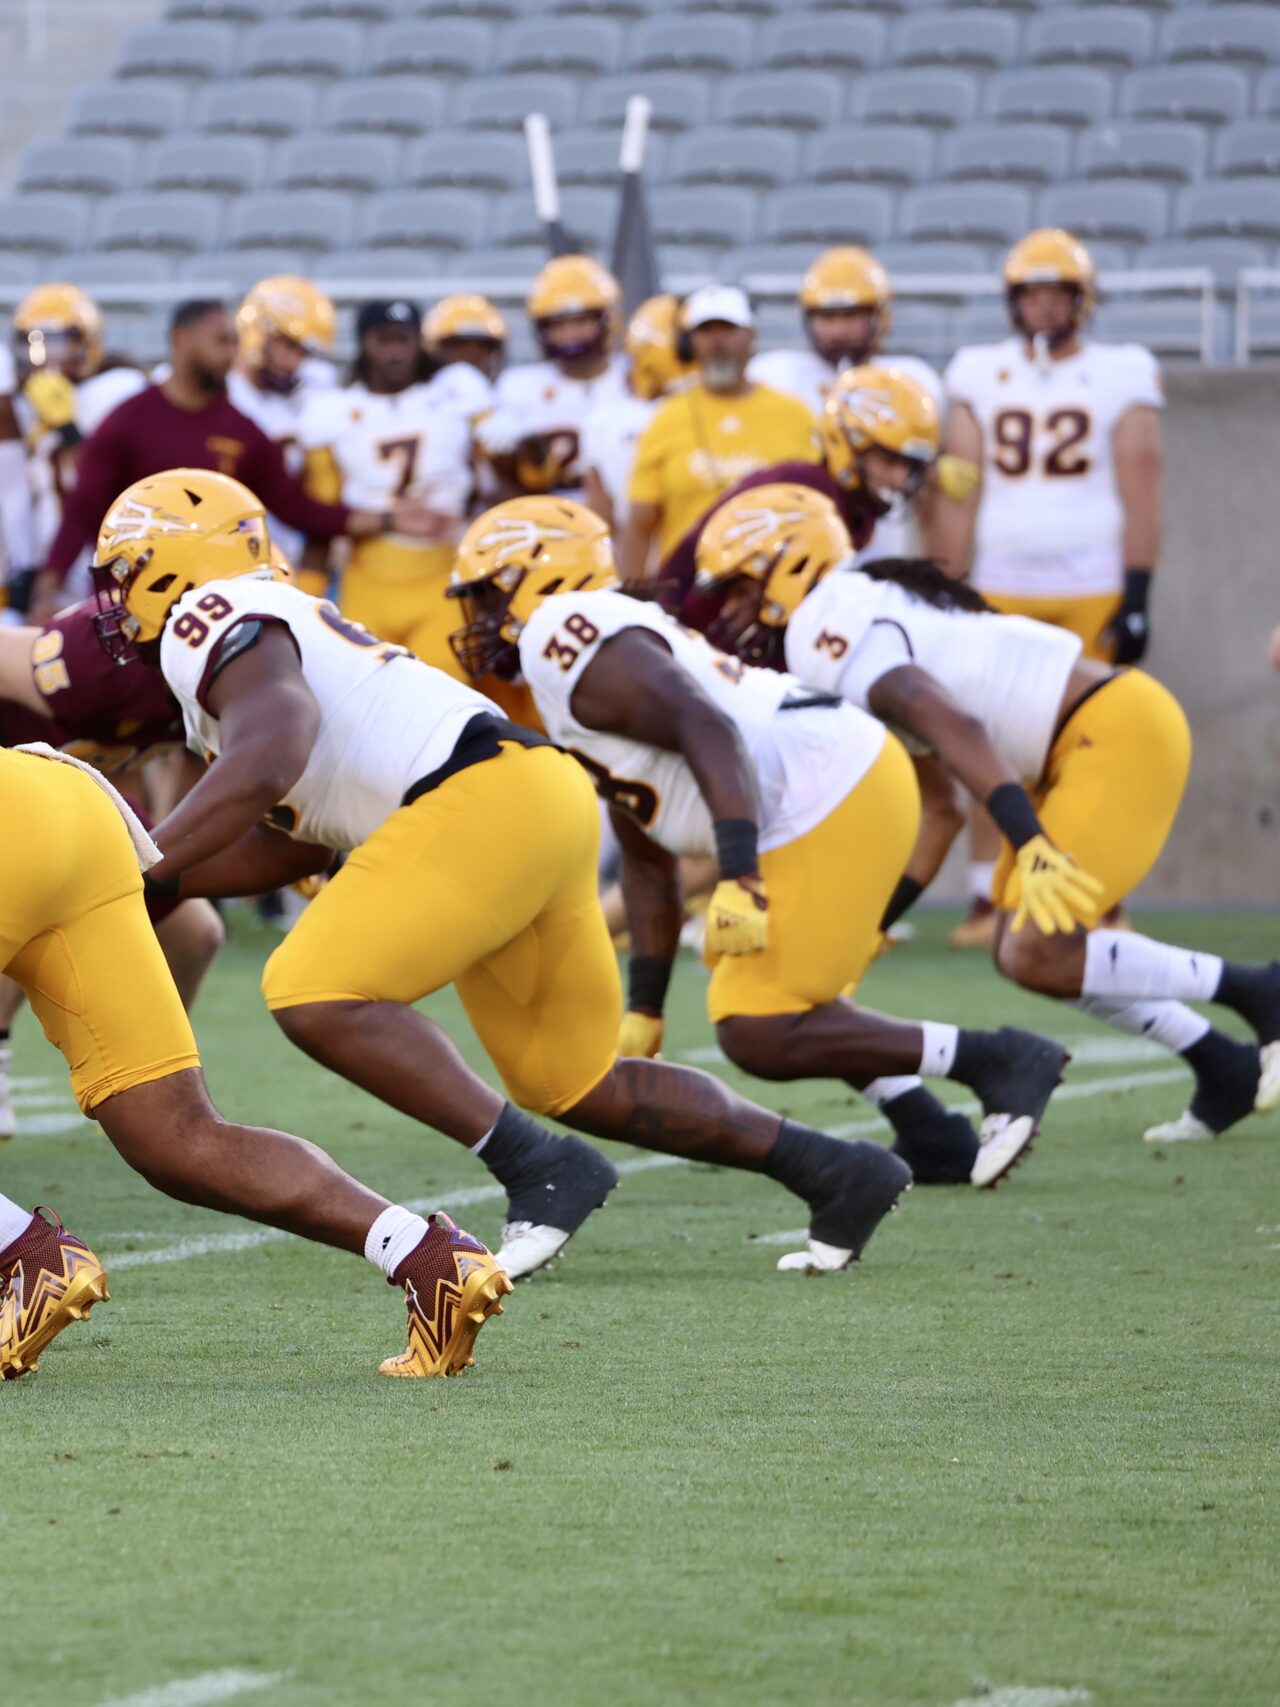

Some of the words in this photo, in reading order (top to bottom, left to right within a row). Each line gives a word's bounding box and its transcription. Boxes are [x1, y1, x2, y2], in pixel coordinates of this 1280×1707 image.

[377, 433, 424, 497] 7
[993, 407, 1092, 478] 92
[172, 592, 234, 650] 99
[541, 612, 600, 672] 38
[814, 628, 849, 660] 3
